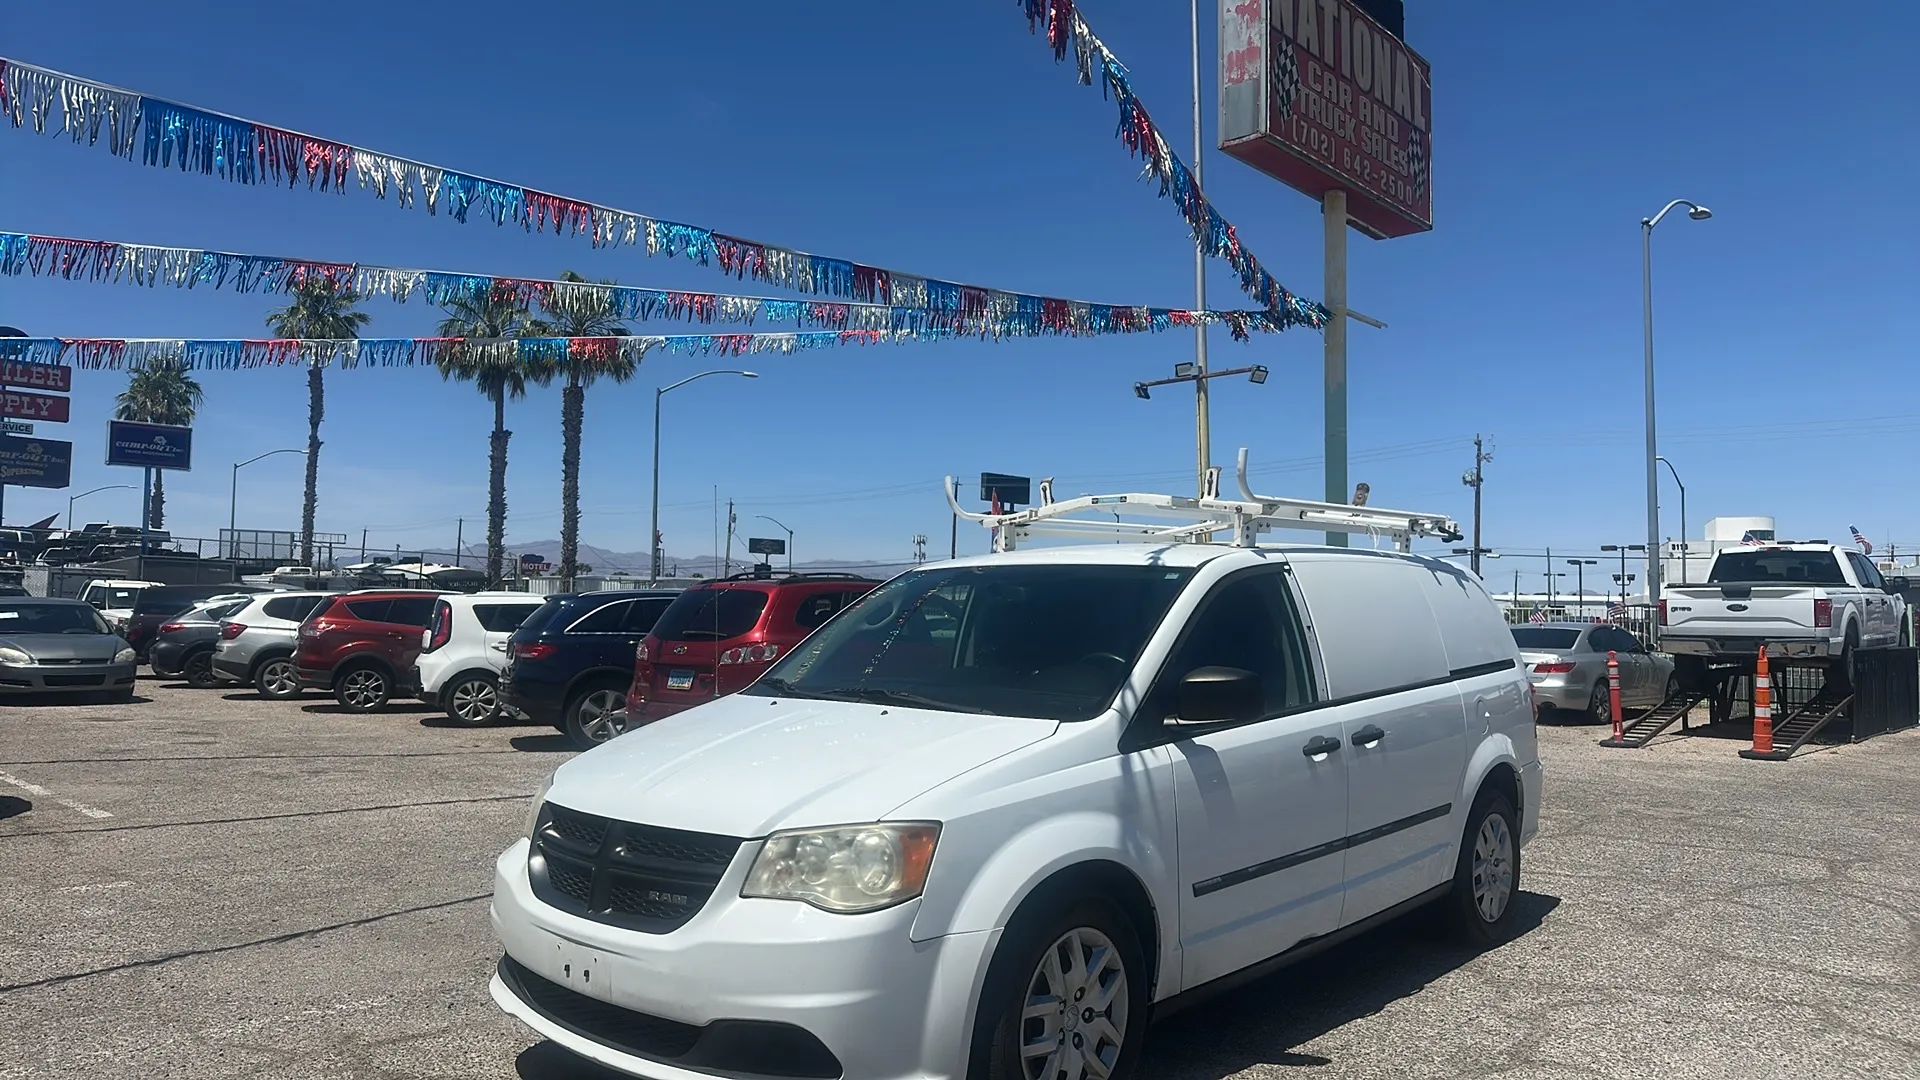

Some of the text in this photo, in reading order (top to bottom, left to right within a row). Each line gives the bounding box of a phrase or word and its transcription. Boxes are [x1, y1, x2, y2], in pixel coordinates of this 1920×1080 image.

[1308, 60, 1399, 143] CAR AND
[1299, 86, 1409, 177] TRUCK SALES
[1293, 114, 1413, 206] (702) 642-2500
[0, 394, 54, 416] PLY
[522, 562, 547, 570] MOTEL
[649, 890, 688, 905] RAM
